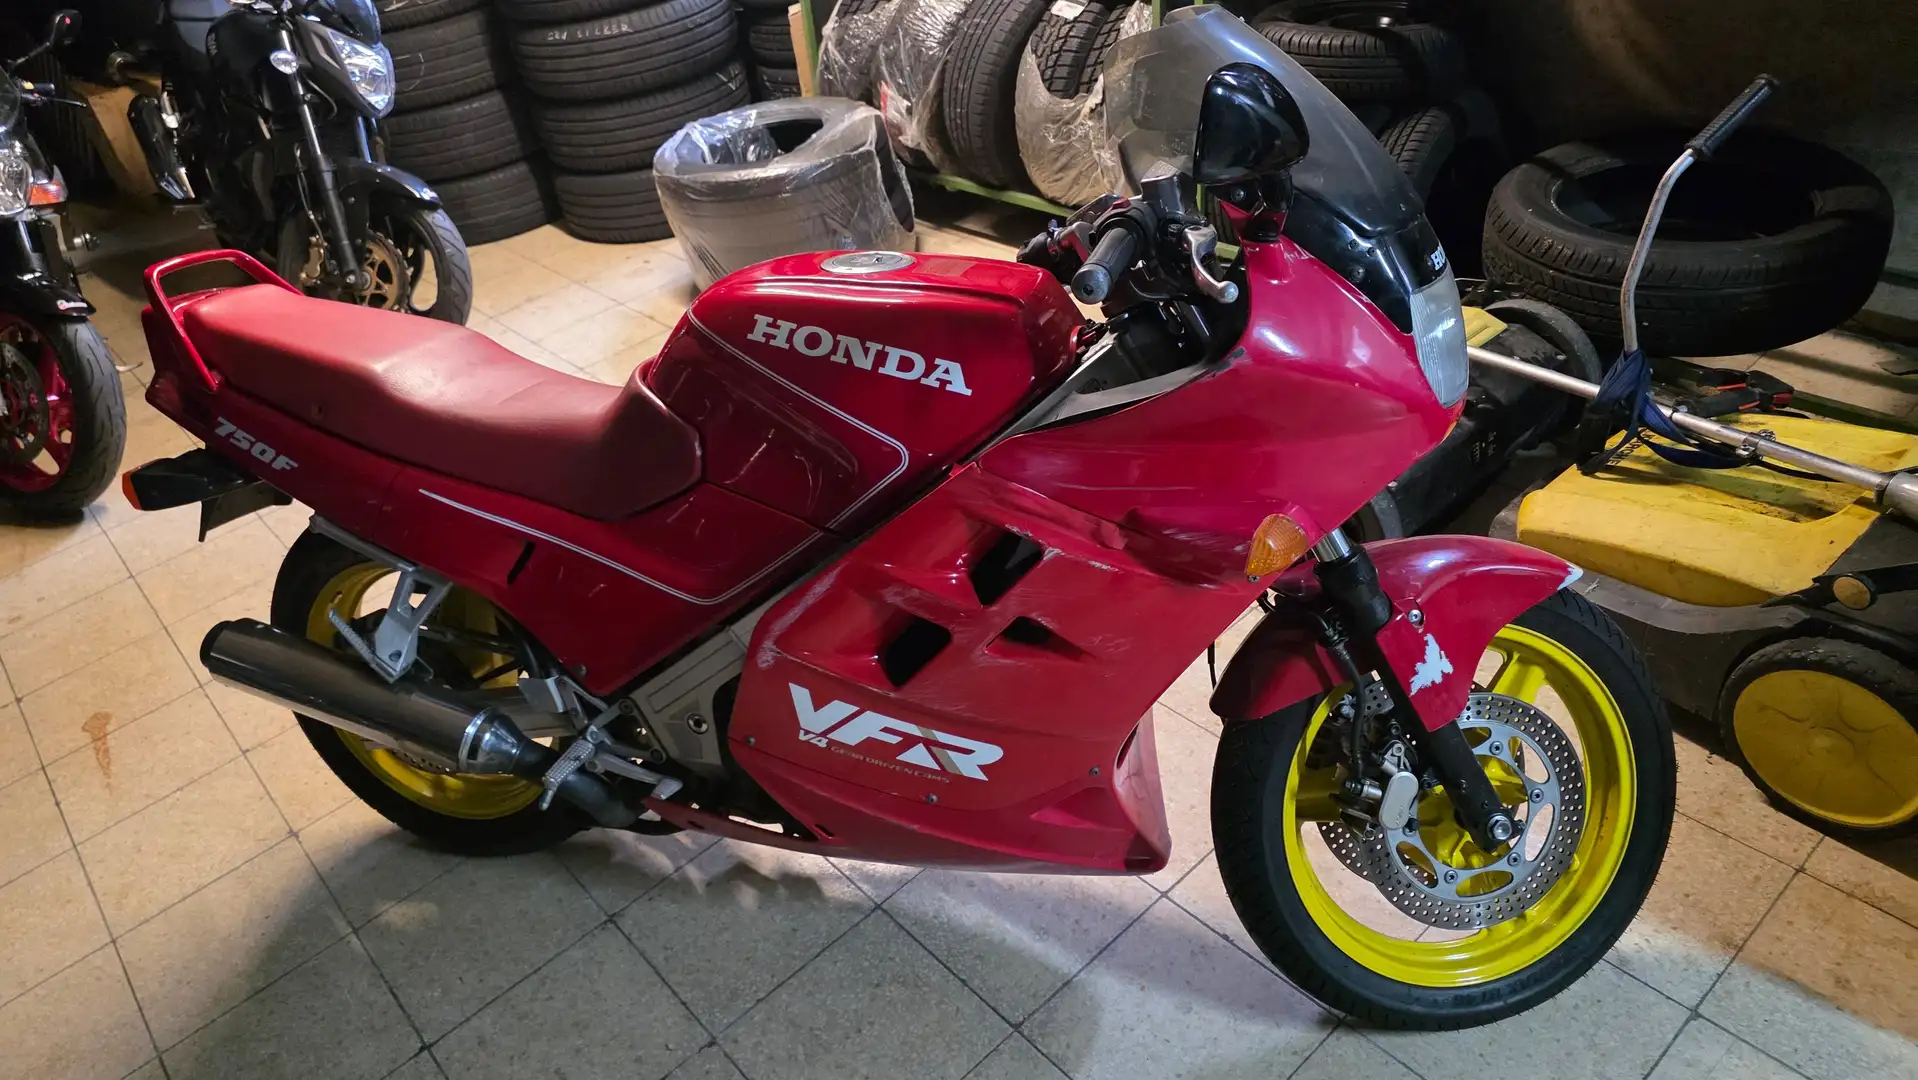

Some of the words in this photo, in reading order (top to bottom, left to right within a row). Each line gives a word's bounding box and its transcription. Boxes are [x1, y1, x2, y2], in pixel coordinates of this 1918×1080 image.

[747, 314, 972, 396] HONDA
[214, 416, 299, 470] 750F
[788, 682, 1004, 781] VFR
[798, 729, 829, 748] V4
[830, 744, 864, 760] GEAR
[865, 756, 913, 775] DRIVEN
[913, 768, 950, 784] CAMS
